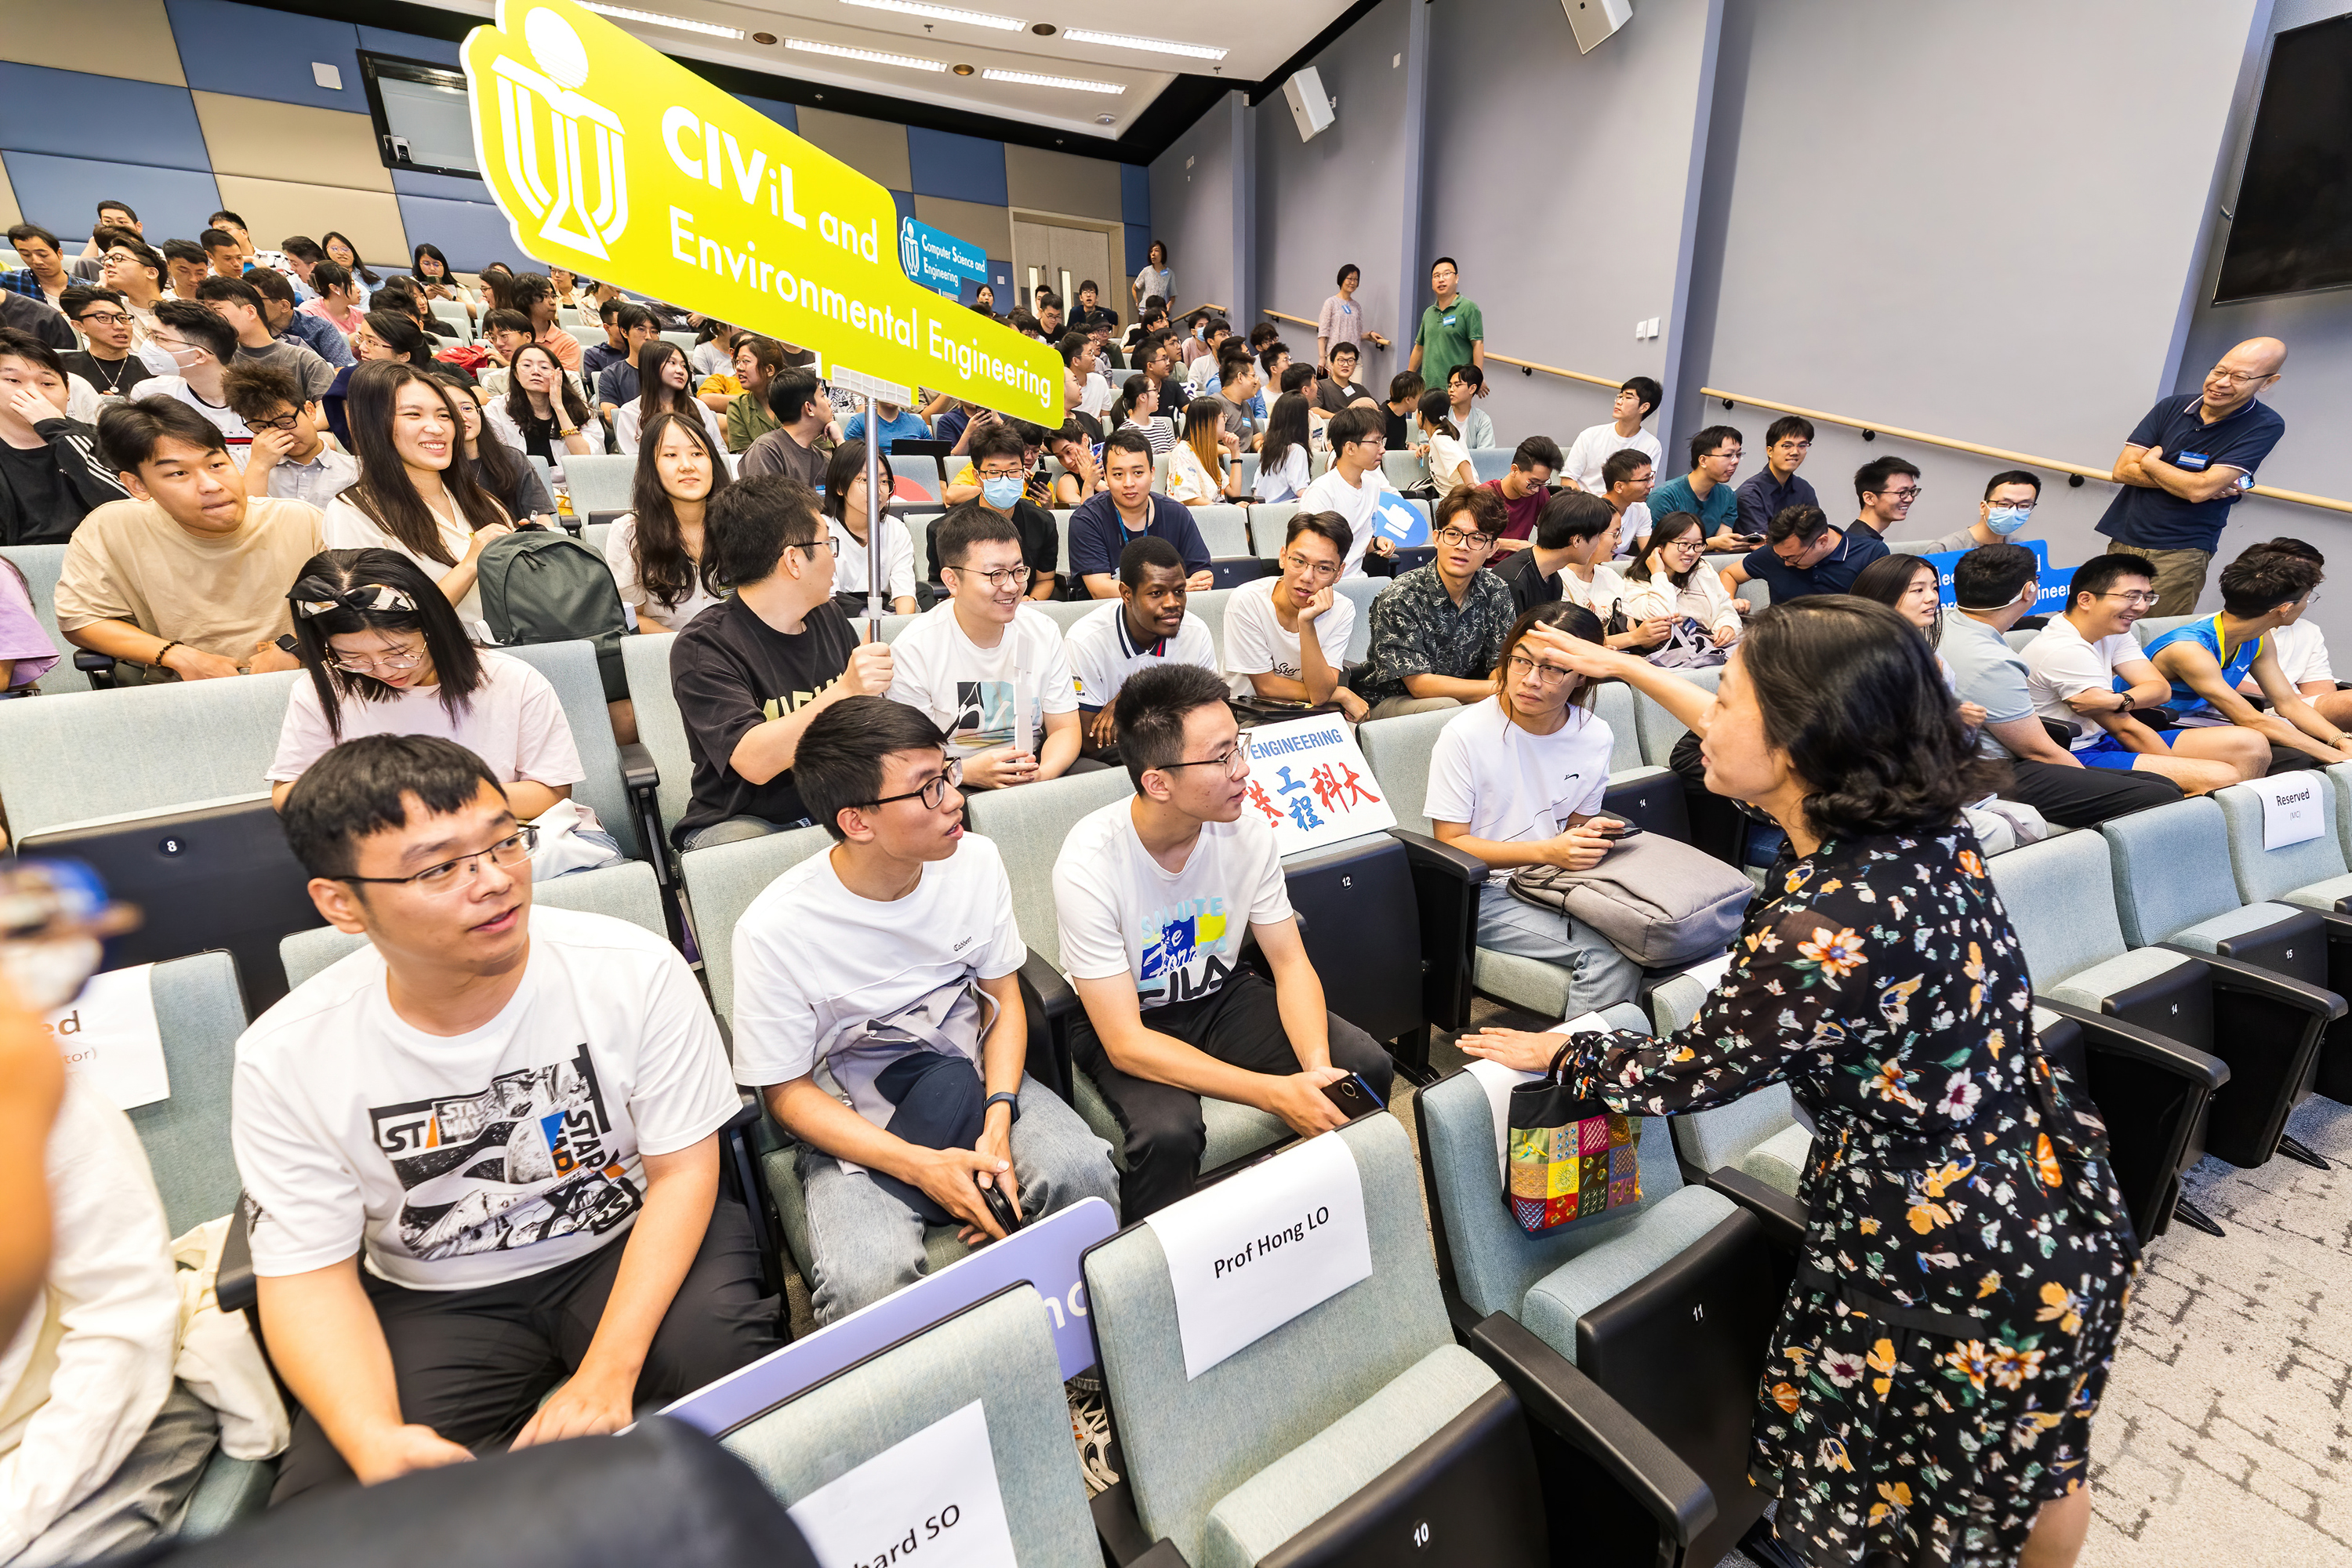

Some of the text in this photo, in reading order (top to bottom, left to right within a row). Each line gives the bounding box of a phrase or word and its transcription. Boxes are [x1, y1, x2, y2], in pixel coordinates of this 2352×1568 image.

[818, 211, 879, 265] and
[921, 234, 985, 273] Computer Science and
[923, 256, 959, 288] Engineering
[669, 205, 1051, 408] Environmental Engineering
[1250, 728, 1344, 760] ENGINEERING
[1639, 798, 1646, 808] 14
[2276, 788, 2310, 807] Reserved
[166, 840, 177, 852] 8
[1341, 876, 1352, 887] 12
[2285, 949, 2293, 960] 15
[2171, 1004, 2178, 1015] 14
[63, 1047, 96, 1065] tor)
[1214, 1206, 1330, 1279] Prof Hong LO
[1693, 1303, 1704, 1322] 11
[854, 1504, 960, 1568] ard SO
[1414, 1522, 1429, 1548] 10
